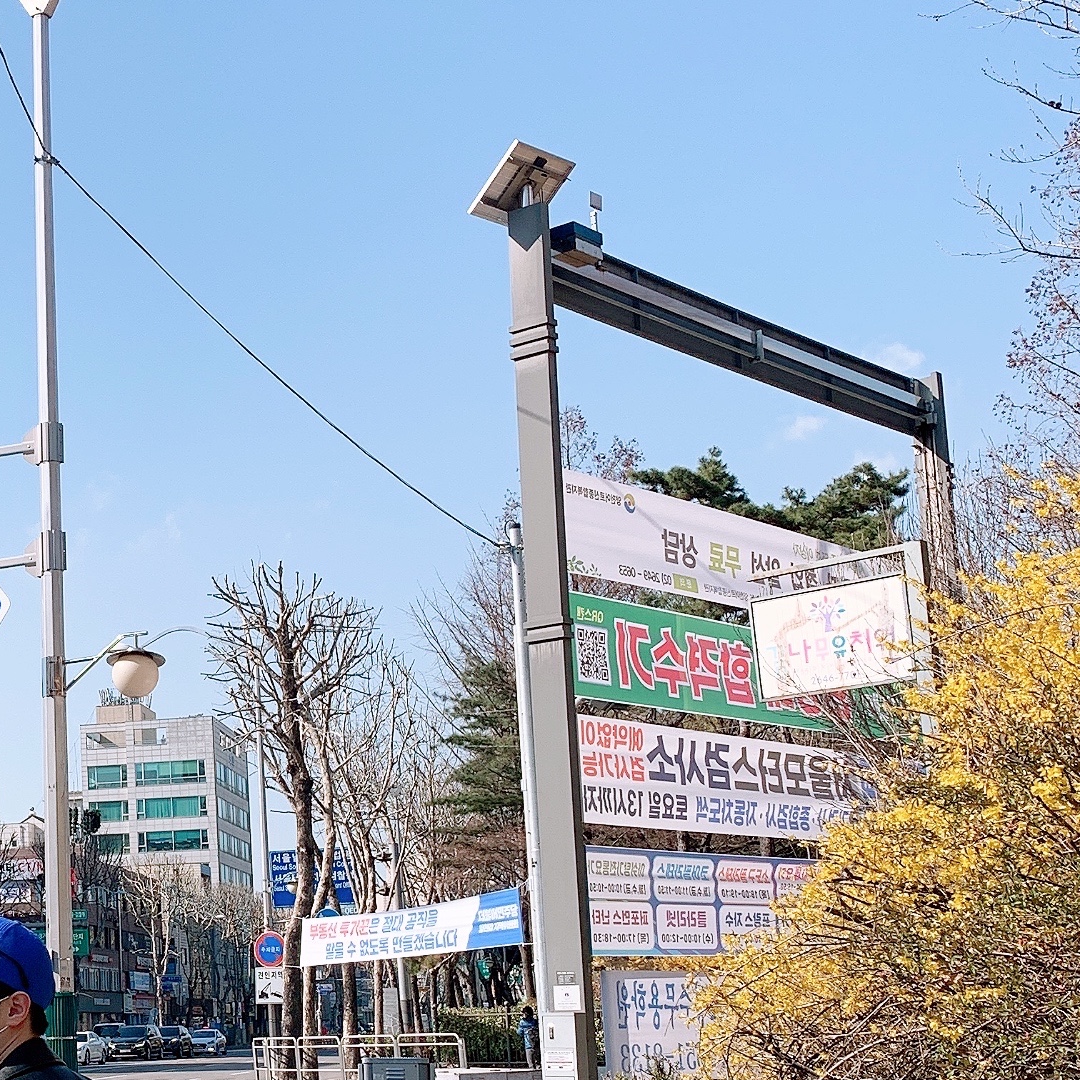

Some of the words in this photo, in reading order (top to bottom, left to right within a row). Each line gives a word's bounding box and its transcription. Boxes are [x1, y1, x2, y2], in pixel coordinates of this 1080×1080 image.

[309, 922, 337, 940] 부동산
[340, 917, 380, 937] 투기꾼은
[382, 914, 403, 933] 절대
[405, 909, 438, 930] 공직을
[326, 941, 343, 959] 맡을
[347, 940, 356, 958] 수
[360, 937, 389, 956] 없도록
[393, 928, 458, 953] 만들겠습니다
